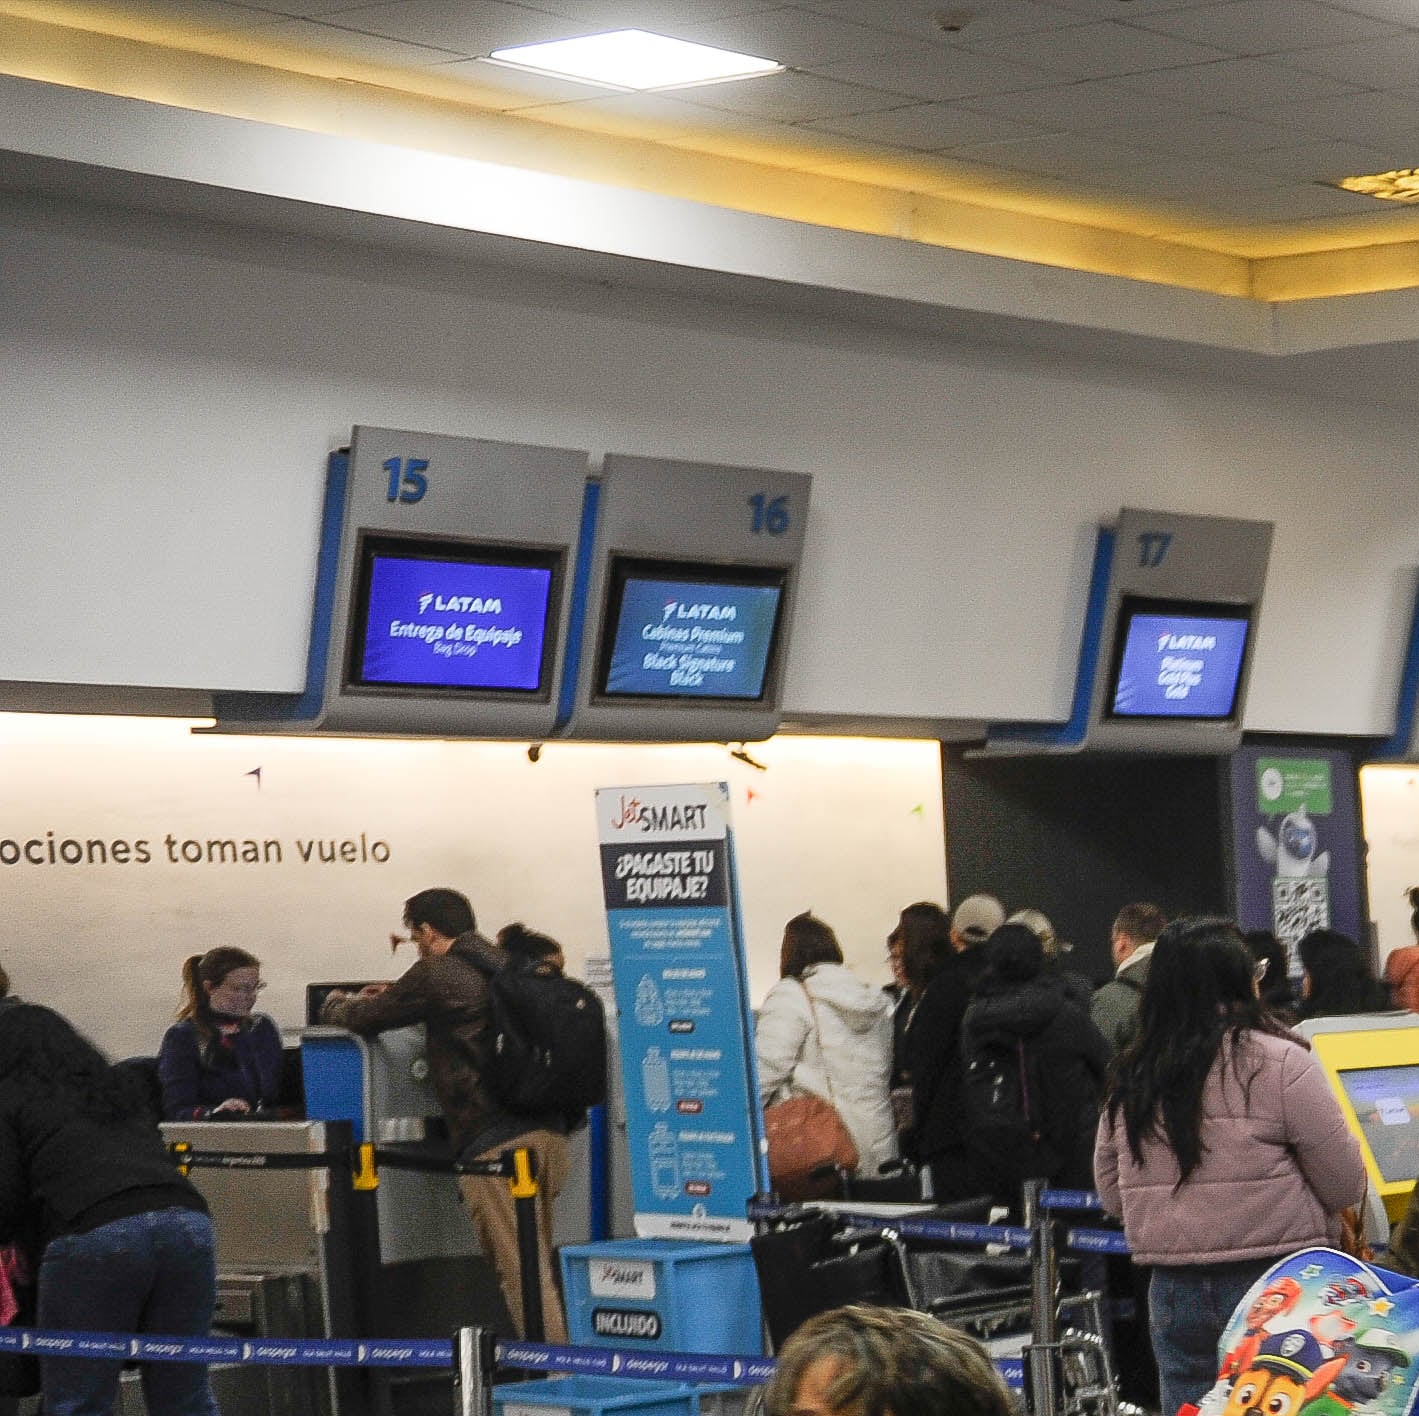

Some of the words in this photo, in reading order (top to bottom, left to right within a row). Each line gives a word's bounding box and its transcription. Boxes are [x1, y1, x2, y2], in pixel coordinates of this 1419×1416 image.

[382, 457, 428, 503] 15
[748, 495, 789, 533] 16
[1137, 532, 1171, 567] 17
[434, 595, 502, 614] LATAM
[677, 603, 737, 621] LATAM
[389, 620, 443, 643] Entrega
[445, 623, 463, 640] de
[464, 624, 523, 648] Equipaje
[690, 626, 745, 644] Premium
[1168, 635, 1216, 651] LATAM
[611, 795, 708, 832] JetSMART
[0, 831, 152, 865] ociones
[164, 833, 283, 864] toman
[295, 832, 392, 864] vuelo
[614, 850, 692, 880] ¿PAGASTE
[692, 849, 714, 875] TU
[625, 875, 709, 904] EQUIPAJE?
[595, 1312, 657, 1337] INCLUIDO
